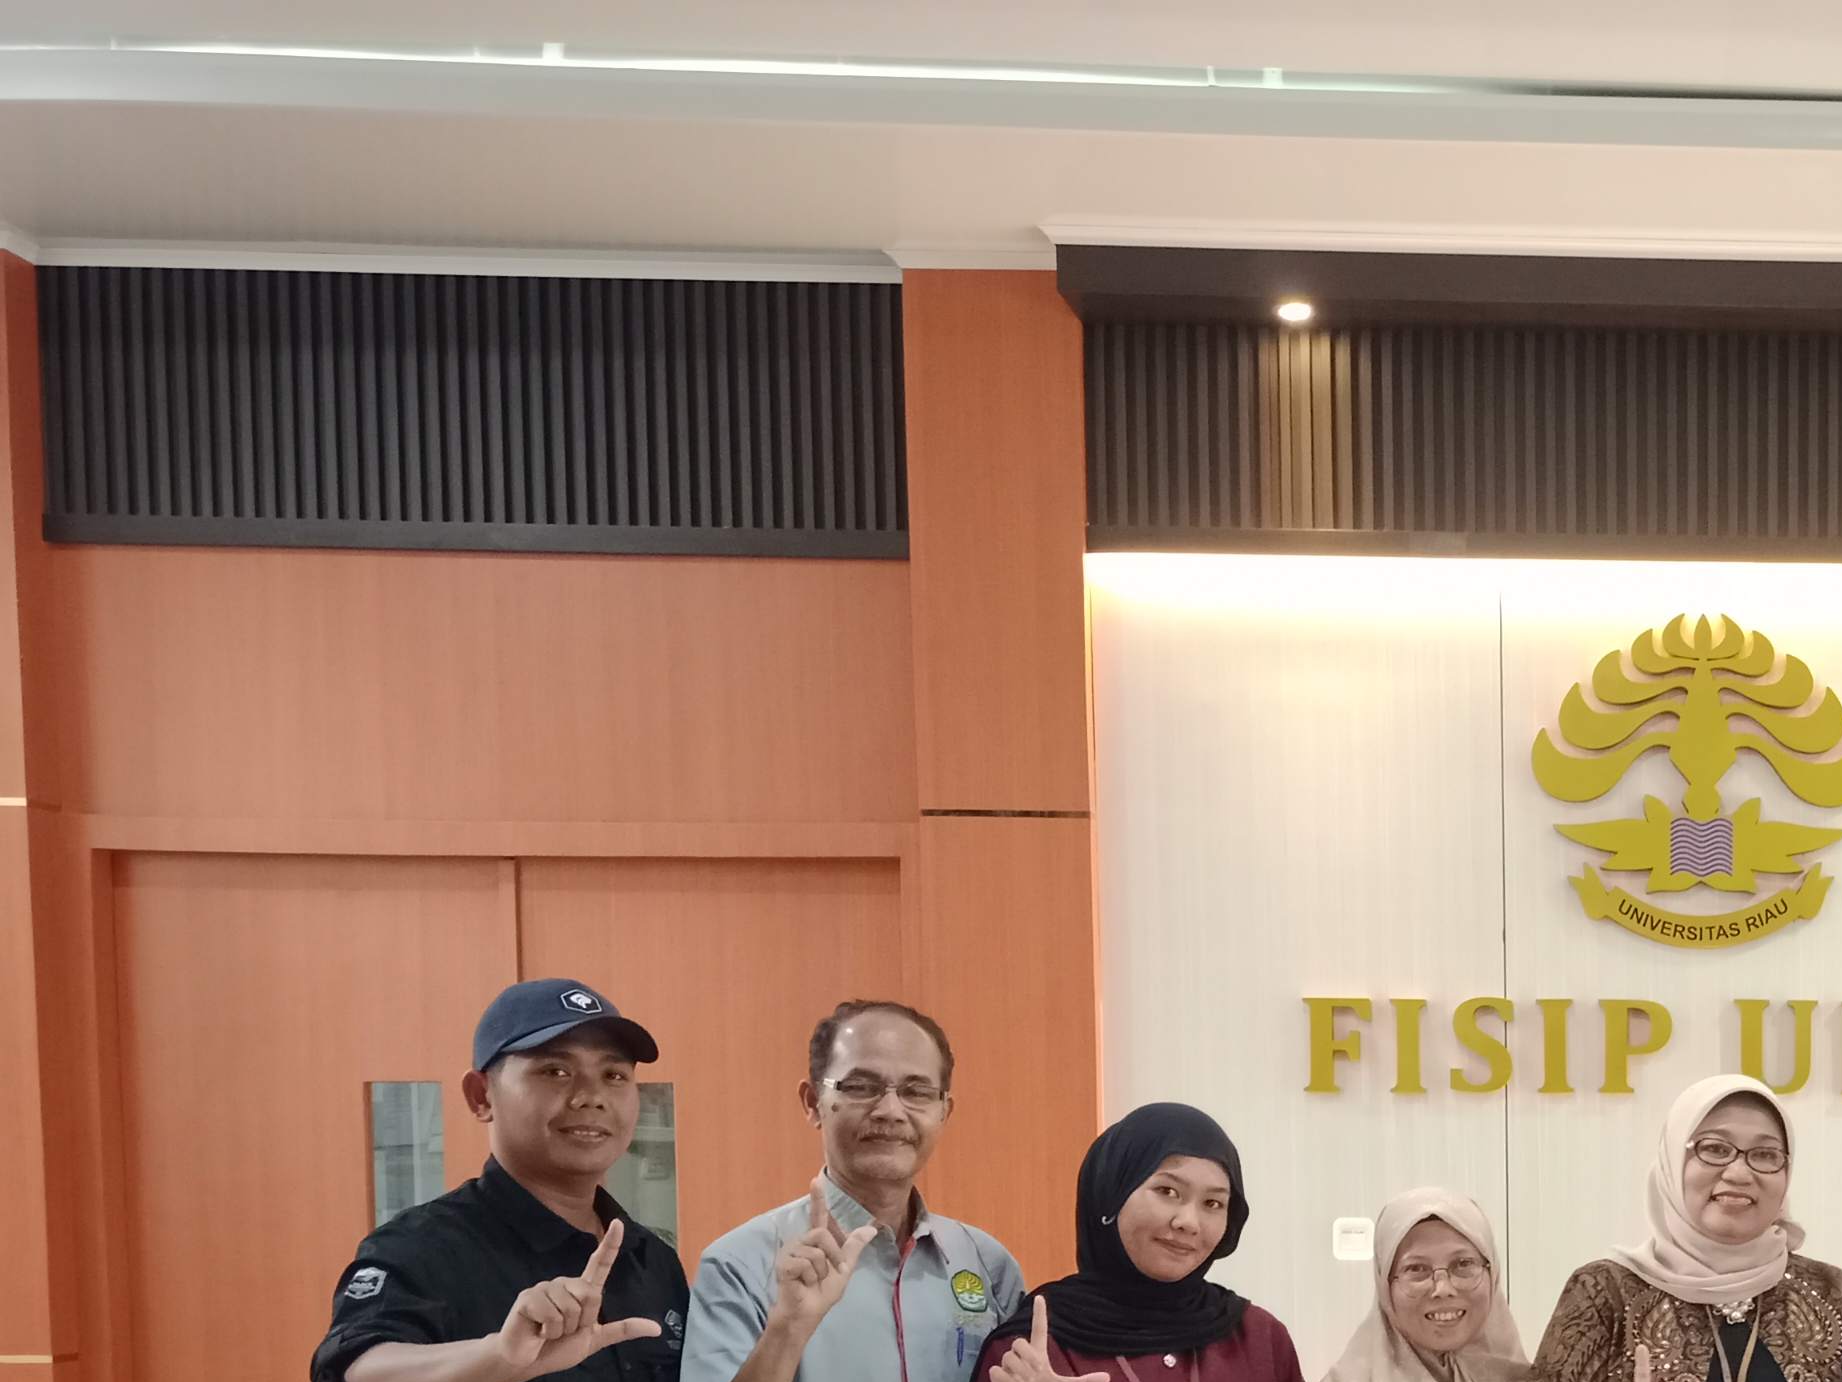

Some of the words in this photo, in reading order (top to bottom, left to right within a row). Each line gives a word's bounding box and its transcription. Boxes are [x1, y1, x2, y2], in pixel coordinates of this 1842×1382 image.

[1617, 898, 1741, 942] UNIVERSITAS
[1744, 897, 1789, 933] RIAU
[1301, 996, 1673, 1094] FISIP
